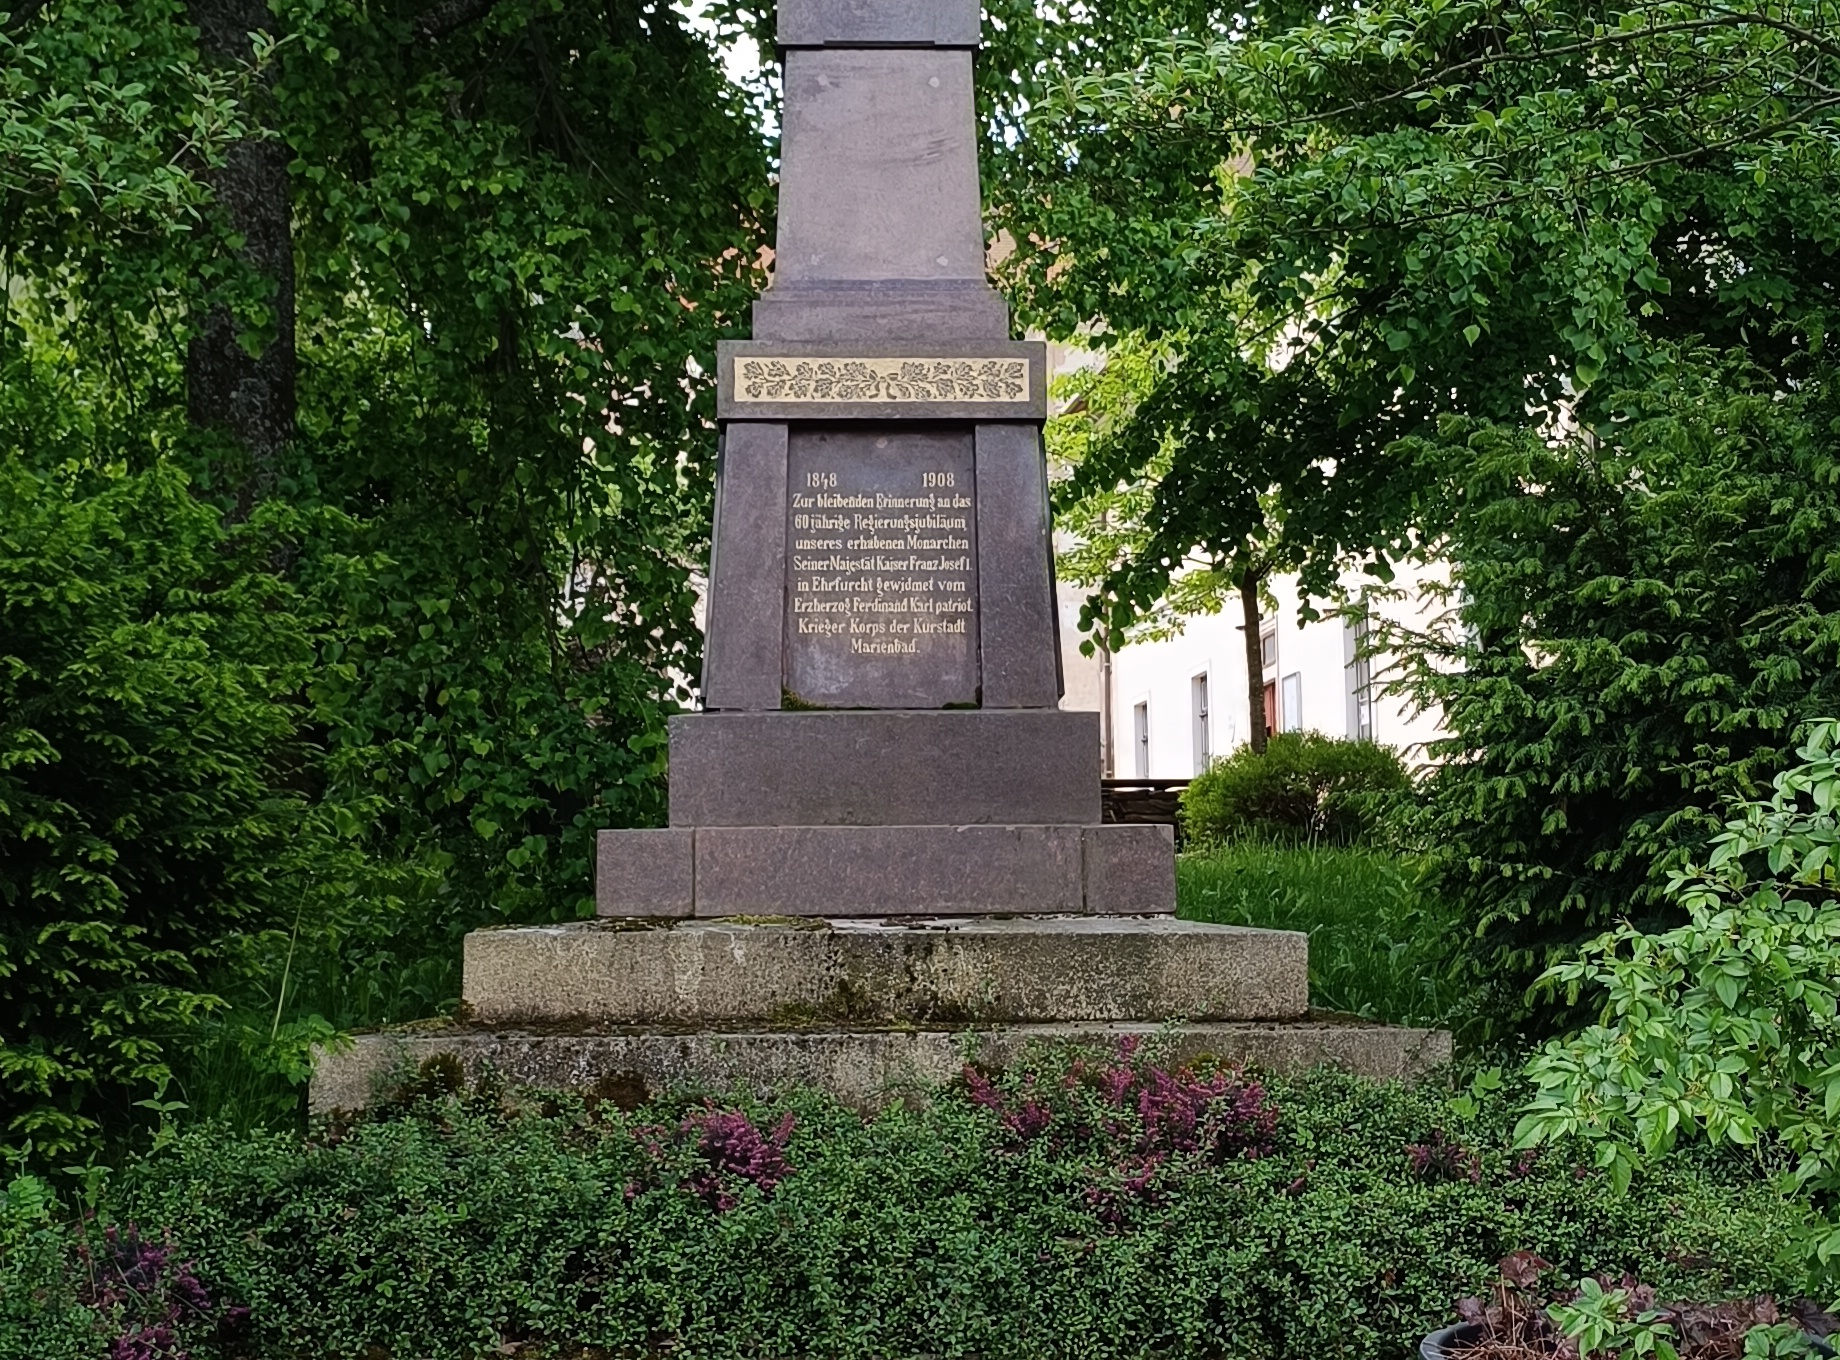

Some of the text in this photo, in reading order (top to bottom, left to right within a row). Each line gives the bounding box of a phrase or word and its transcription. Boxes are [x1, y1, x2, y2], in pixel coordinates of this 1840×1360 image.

[806, 472, 837, 490] 1848
[922, 472, 955, 488] 1908
[792, 492, 971, 512] Zur bleibenden Erinnerung an das
[795, 535, 969, 550] unseres erhabenen Monarchen
[793, 555, 829, 571] Seiner
[909, 555, 938, 571] Franz
[797, 577, 809, 591] in
[812, 576, 873, 592] Ehrfurcht
[937, 580, 966, 591] vom
[794, 597, 851, 617] Erzherzog
[853, 597, 908, 612] Ferdinand
[909, 597, 934, 612] Karl
[798, 617, 966, 637] Krieger Korps der Kurstadt
